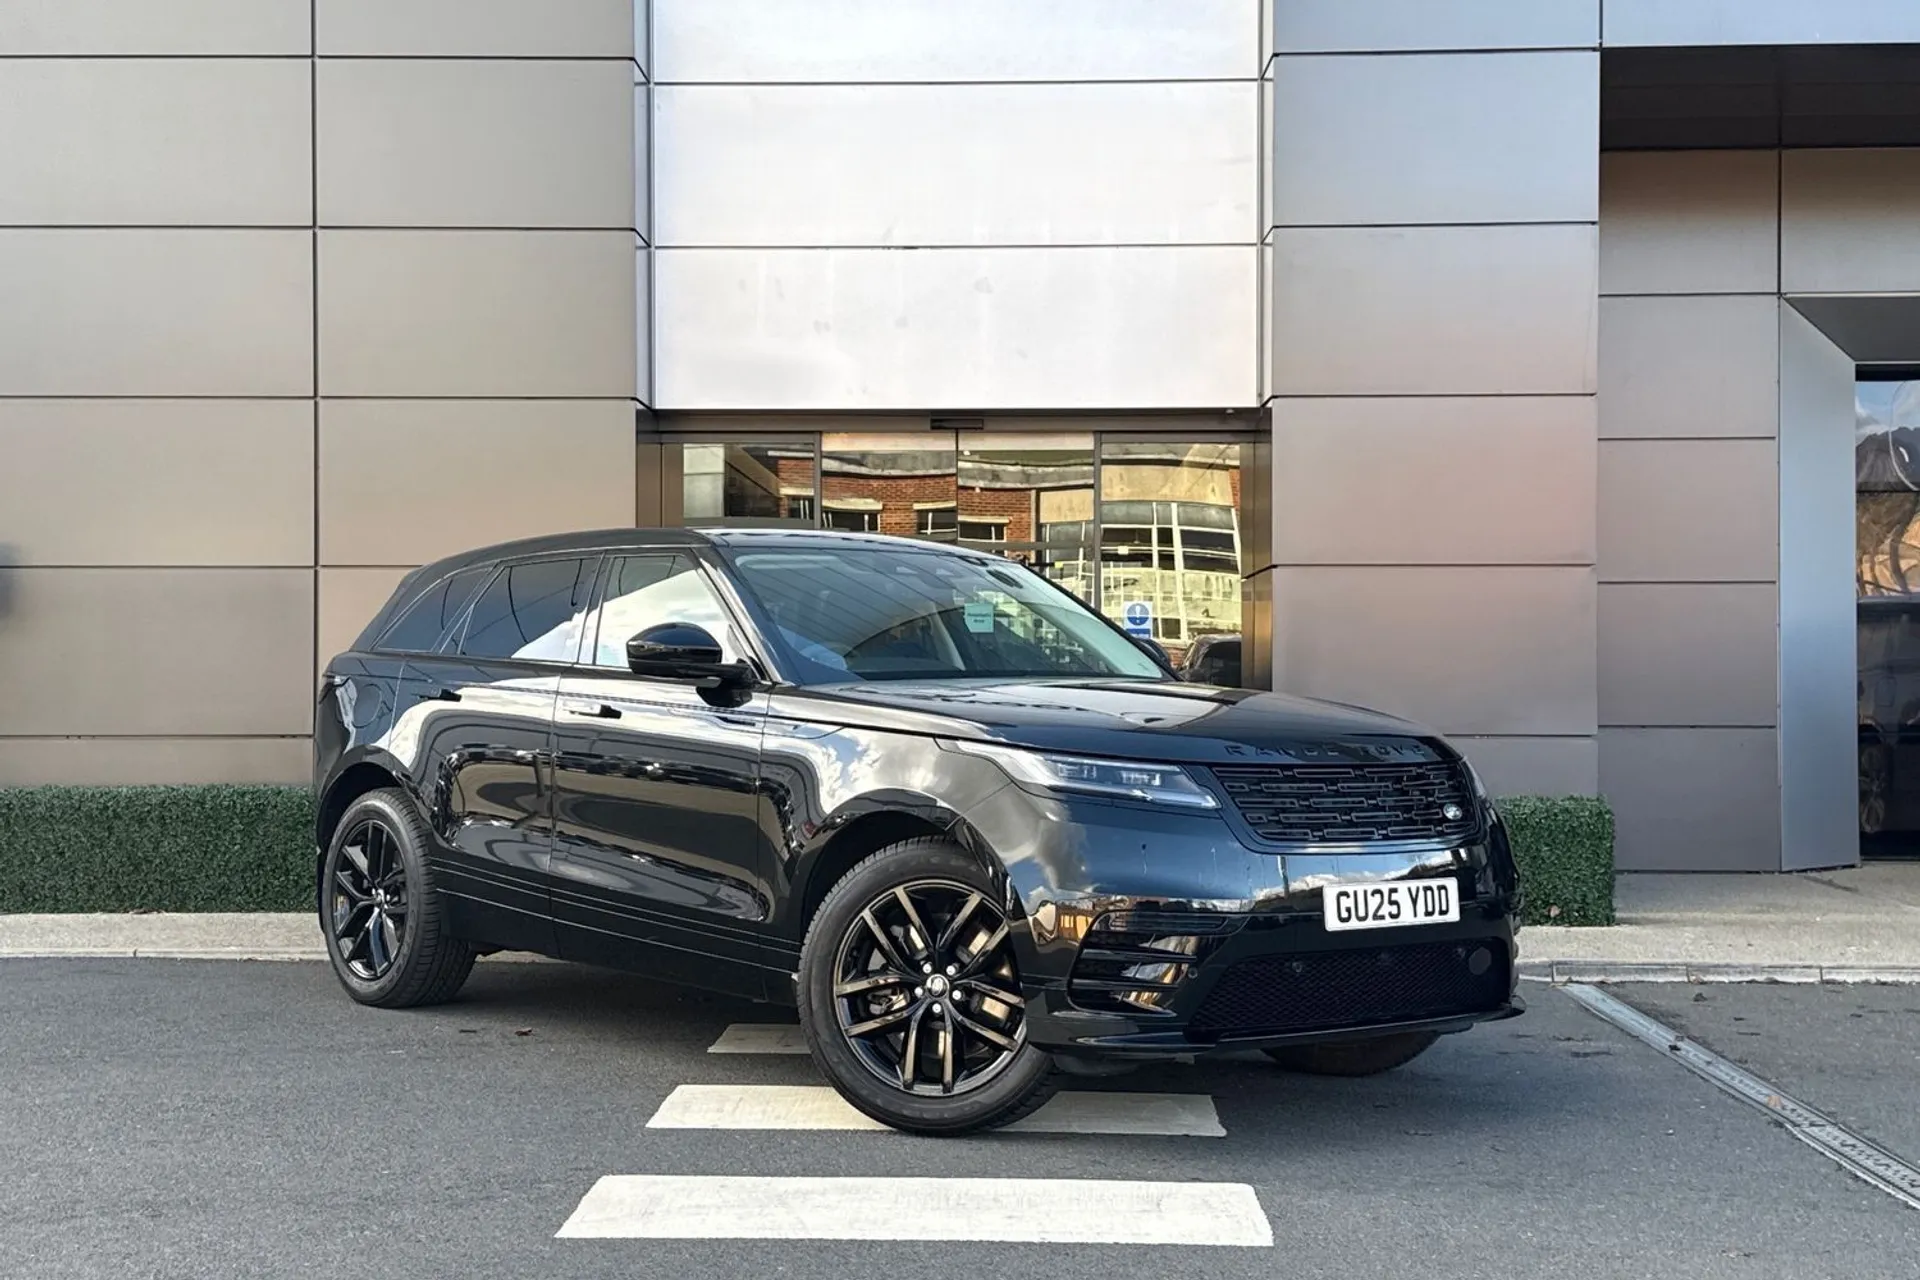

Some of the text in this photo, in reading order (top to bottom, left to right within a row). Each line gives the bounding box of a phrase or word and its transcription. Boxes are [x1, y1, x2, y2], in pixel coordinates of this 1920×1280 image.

[1358, 742, 1428, 757] ROVE
[1336, 884, 1450, 924] GU25 YDD
